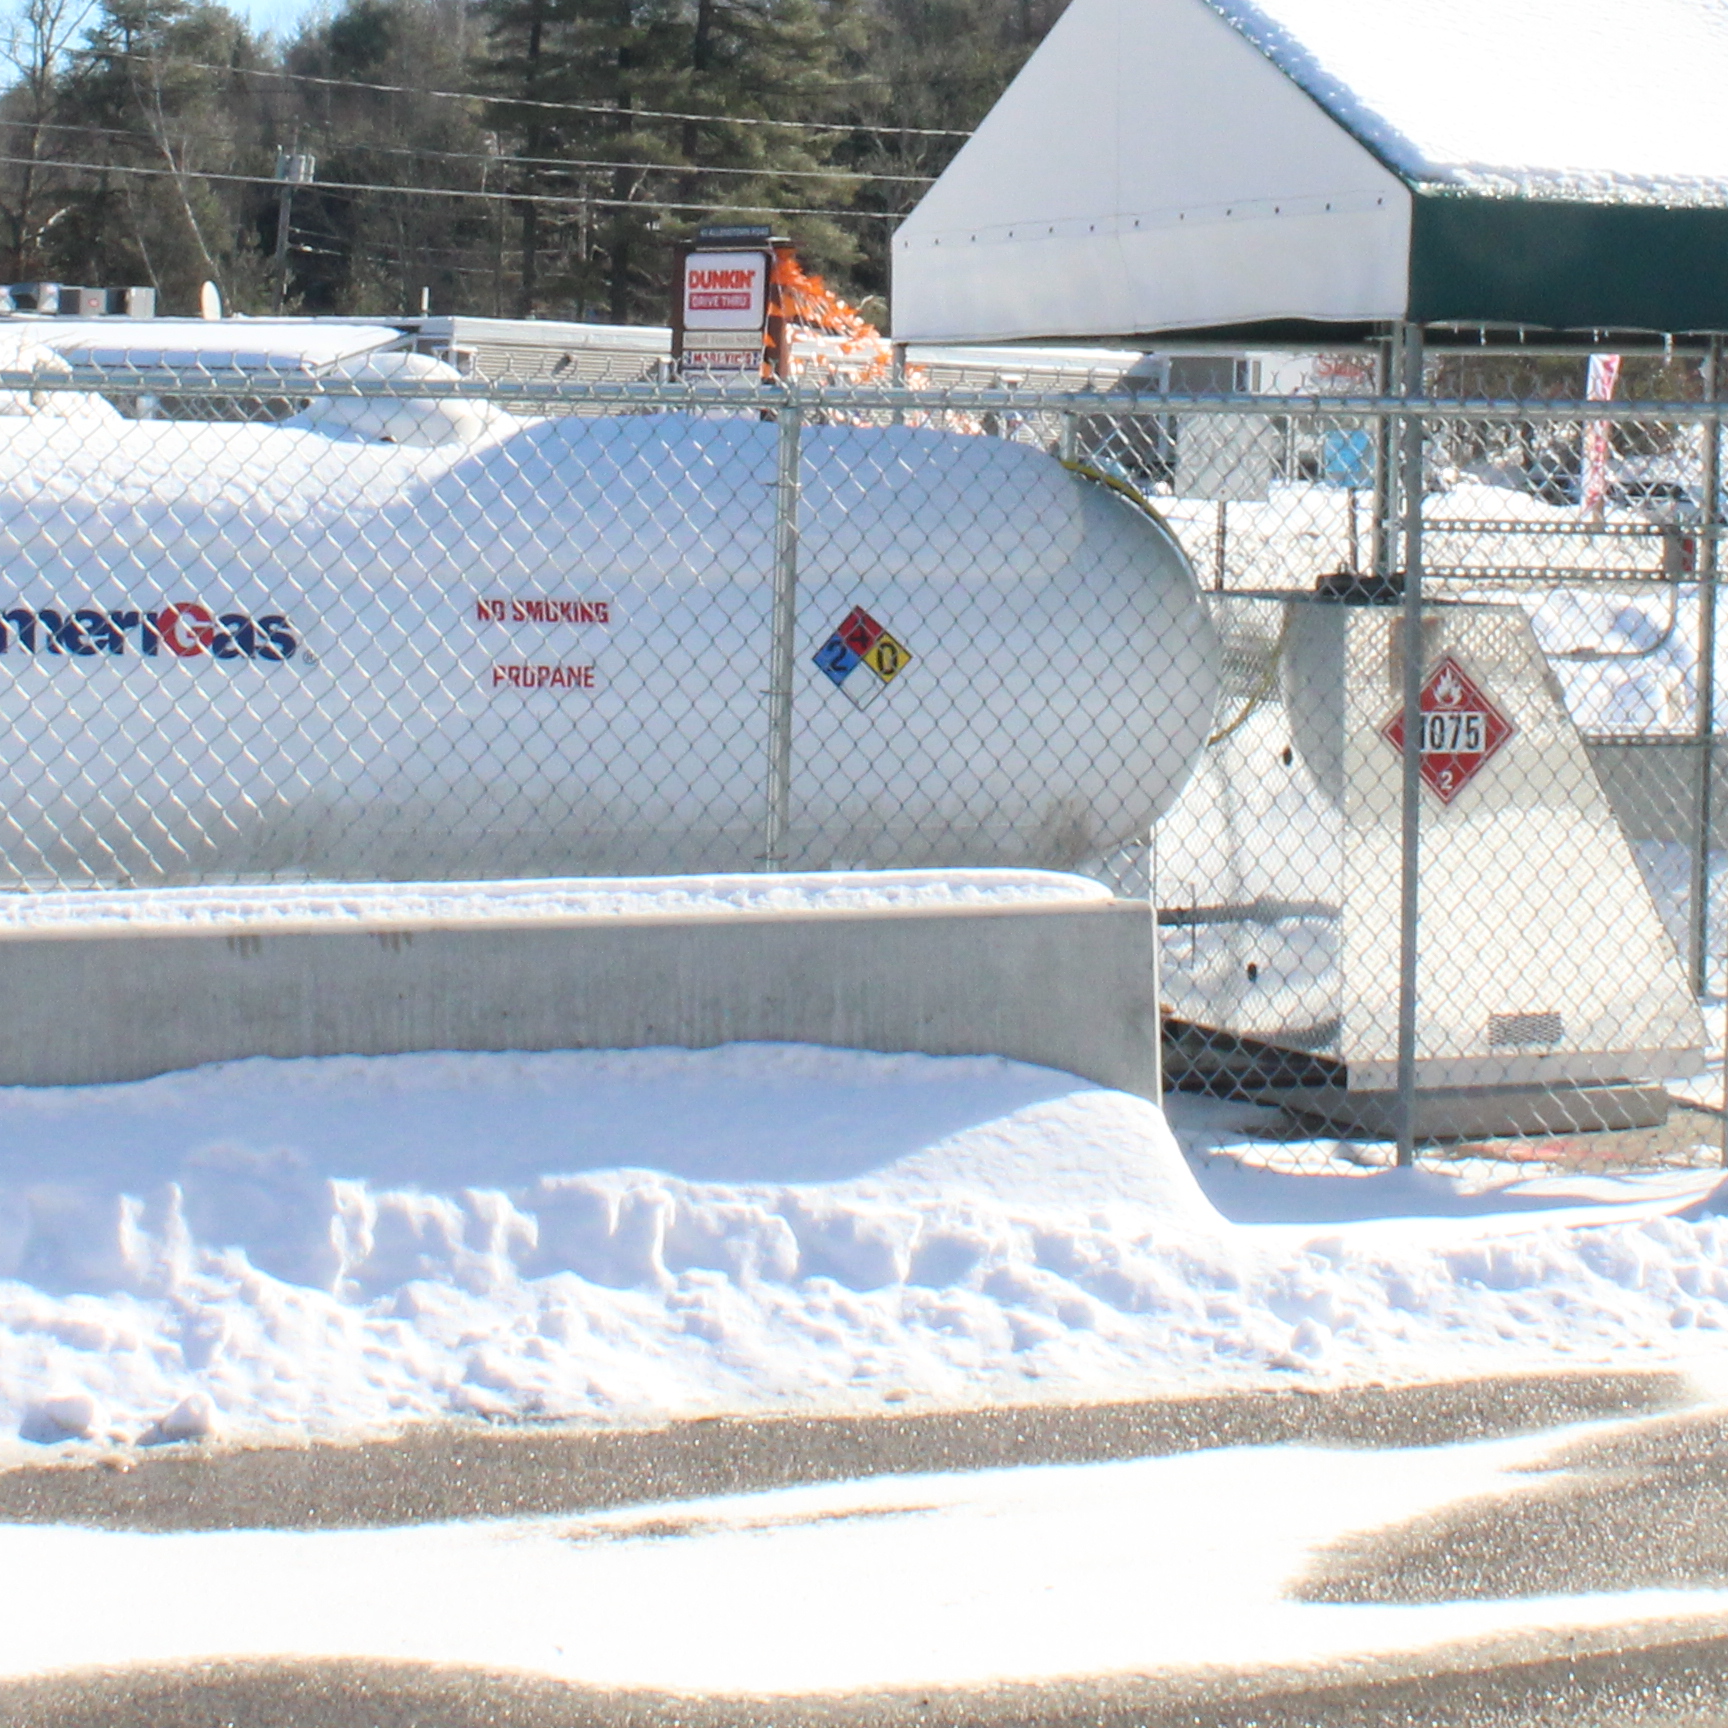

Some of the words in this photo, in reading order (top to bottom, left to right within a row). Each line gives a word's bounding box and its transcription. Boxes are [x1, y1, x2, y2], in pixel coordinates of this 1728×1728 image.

[688, 270, 756, 289] DUNKIN'
[691, 295, 719, 307] DRIVE
[721, 295, 747, 307] THRU
[477, 600, 505, 621] NO
[512, 600, 609, 623] SMOKING
[827, 640, 847, 671] 2
[878, 643, 898, 674] 0
[493, 665, 595, 688] PROPANE
[1440, 771, 1454, 789] 2
